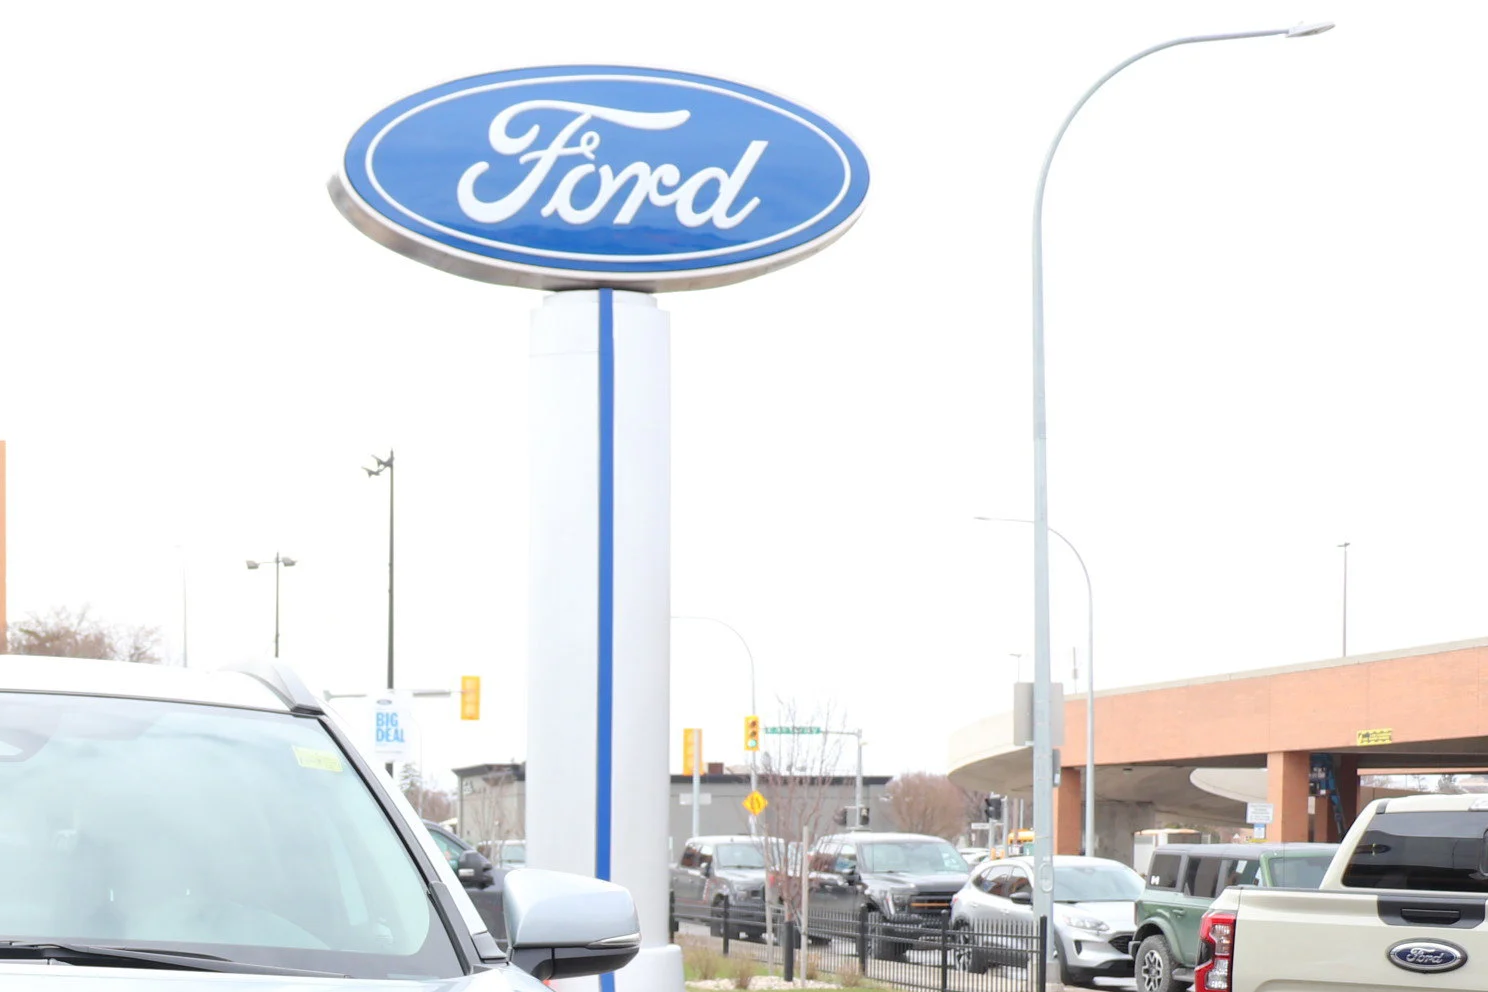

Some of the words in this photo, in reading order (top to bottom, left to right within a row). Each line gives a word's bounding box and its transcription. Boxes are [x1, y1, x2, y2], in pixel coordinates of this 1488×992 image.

[457, 99, 768, 230] Ford
[376, 712, 398, 727] BIG
[376, 728, 405, 742] DEAL
[1406, 948, 1444, 963] Ford
